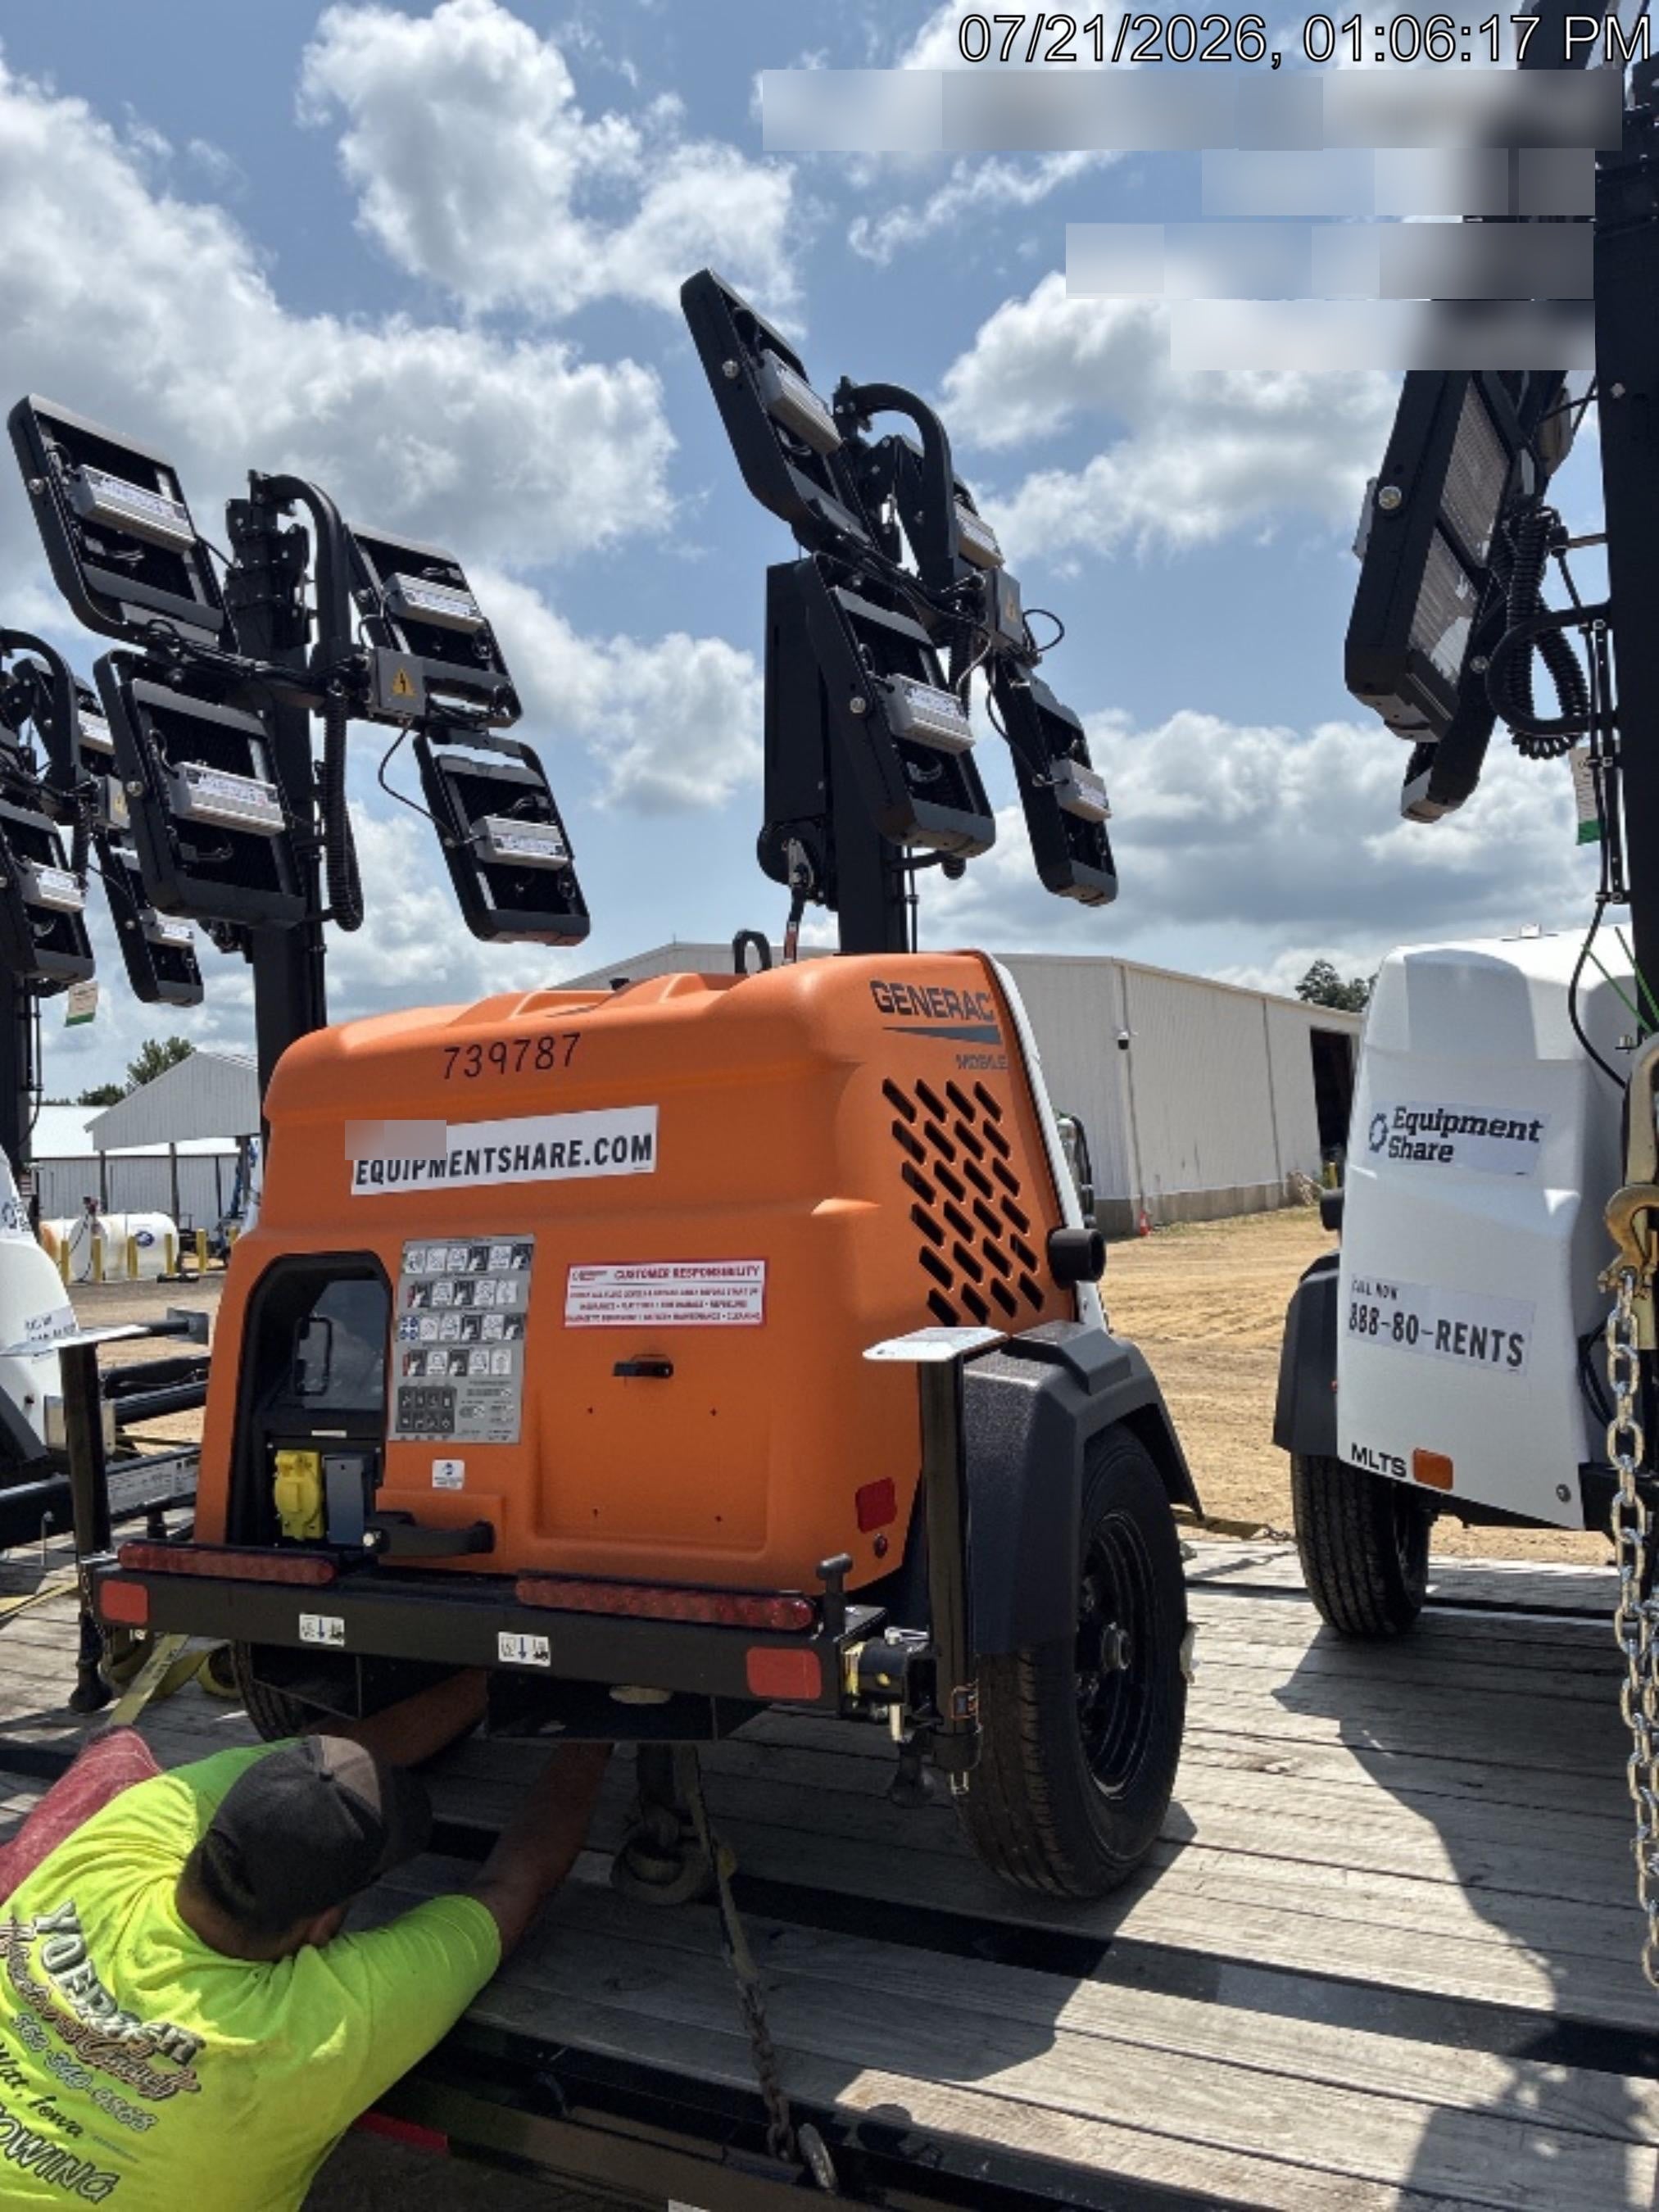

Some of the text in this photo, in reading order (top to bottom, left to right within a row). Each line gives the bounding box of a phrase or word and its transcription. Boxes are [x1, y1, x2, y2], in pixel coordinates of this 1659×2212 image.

[869, 980, 994, 1022] GENERAC
[443, 1032, 581, 1079] 739787
[1392, 1106, 1544, 1143] Equipment
[356, 1133, 652, 1185] EQUIPMENTSHARE.COM
[1389, 1135, 1454, 1163] Share
[1349, 1302, 1525, 1367] 888-80-RENTS
[1352, 1442, 1407, 1478] MLTS
